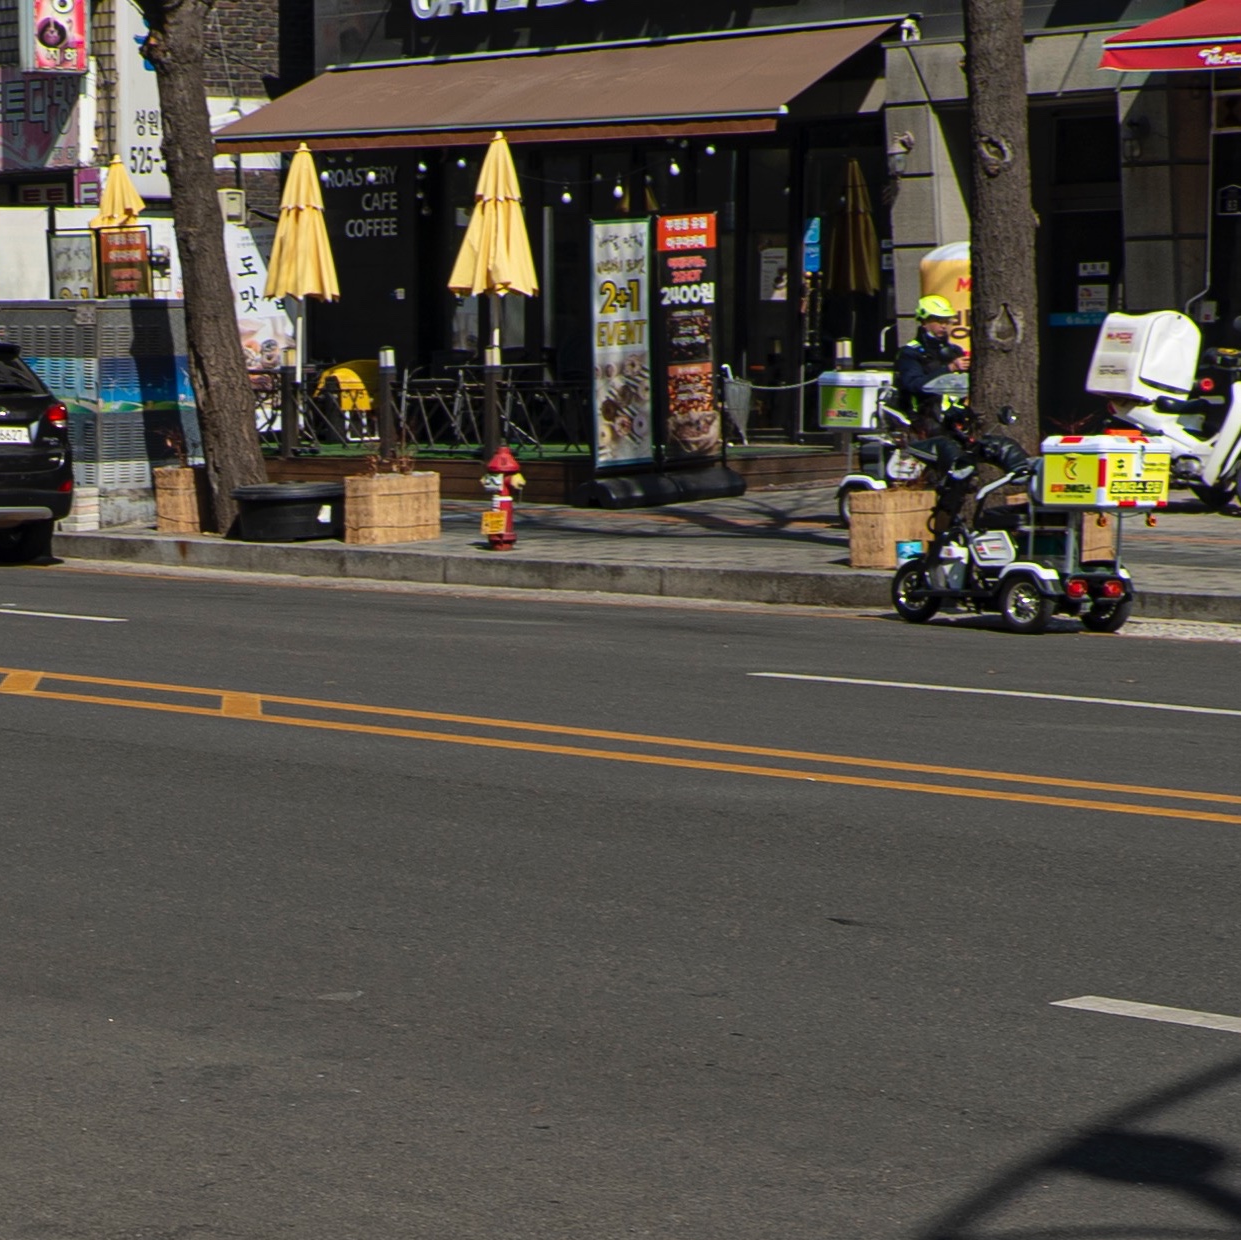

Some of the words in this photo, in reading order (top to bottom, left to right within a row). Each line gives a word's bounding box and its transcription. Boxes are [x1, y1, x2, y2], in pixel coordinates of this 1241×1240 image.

[361, 191, 398, 211] CAFE
[345, 218, 398, 238] COFFEE
[599, 279, 641, 314] 2+1
[660, 282, 715, 305] 2400원
[596, 319, 647, 347] EVENT
